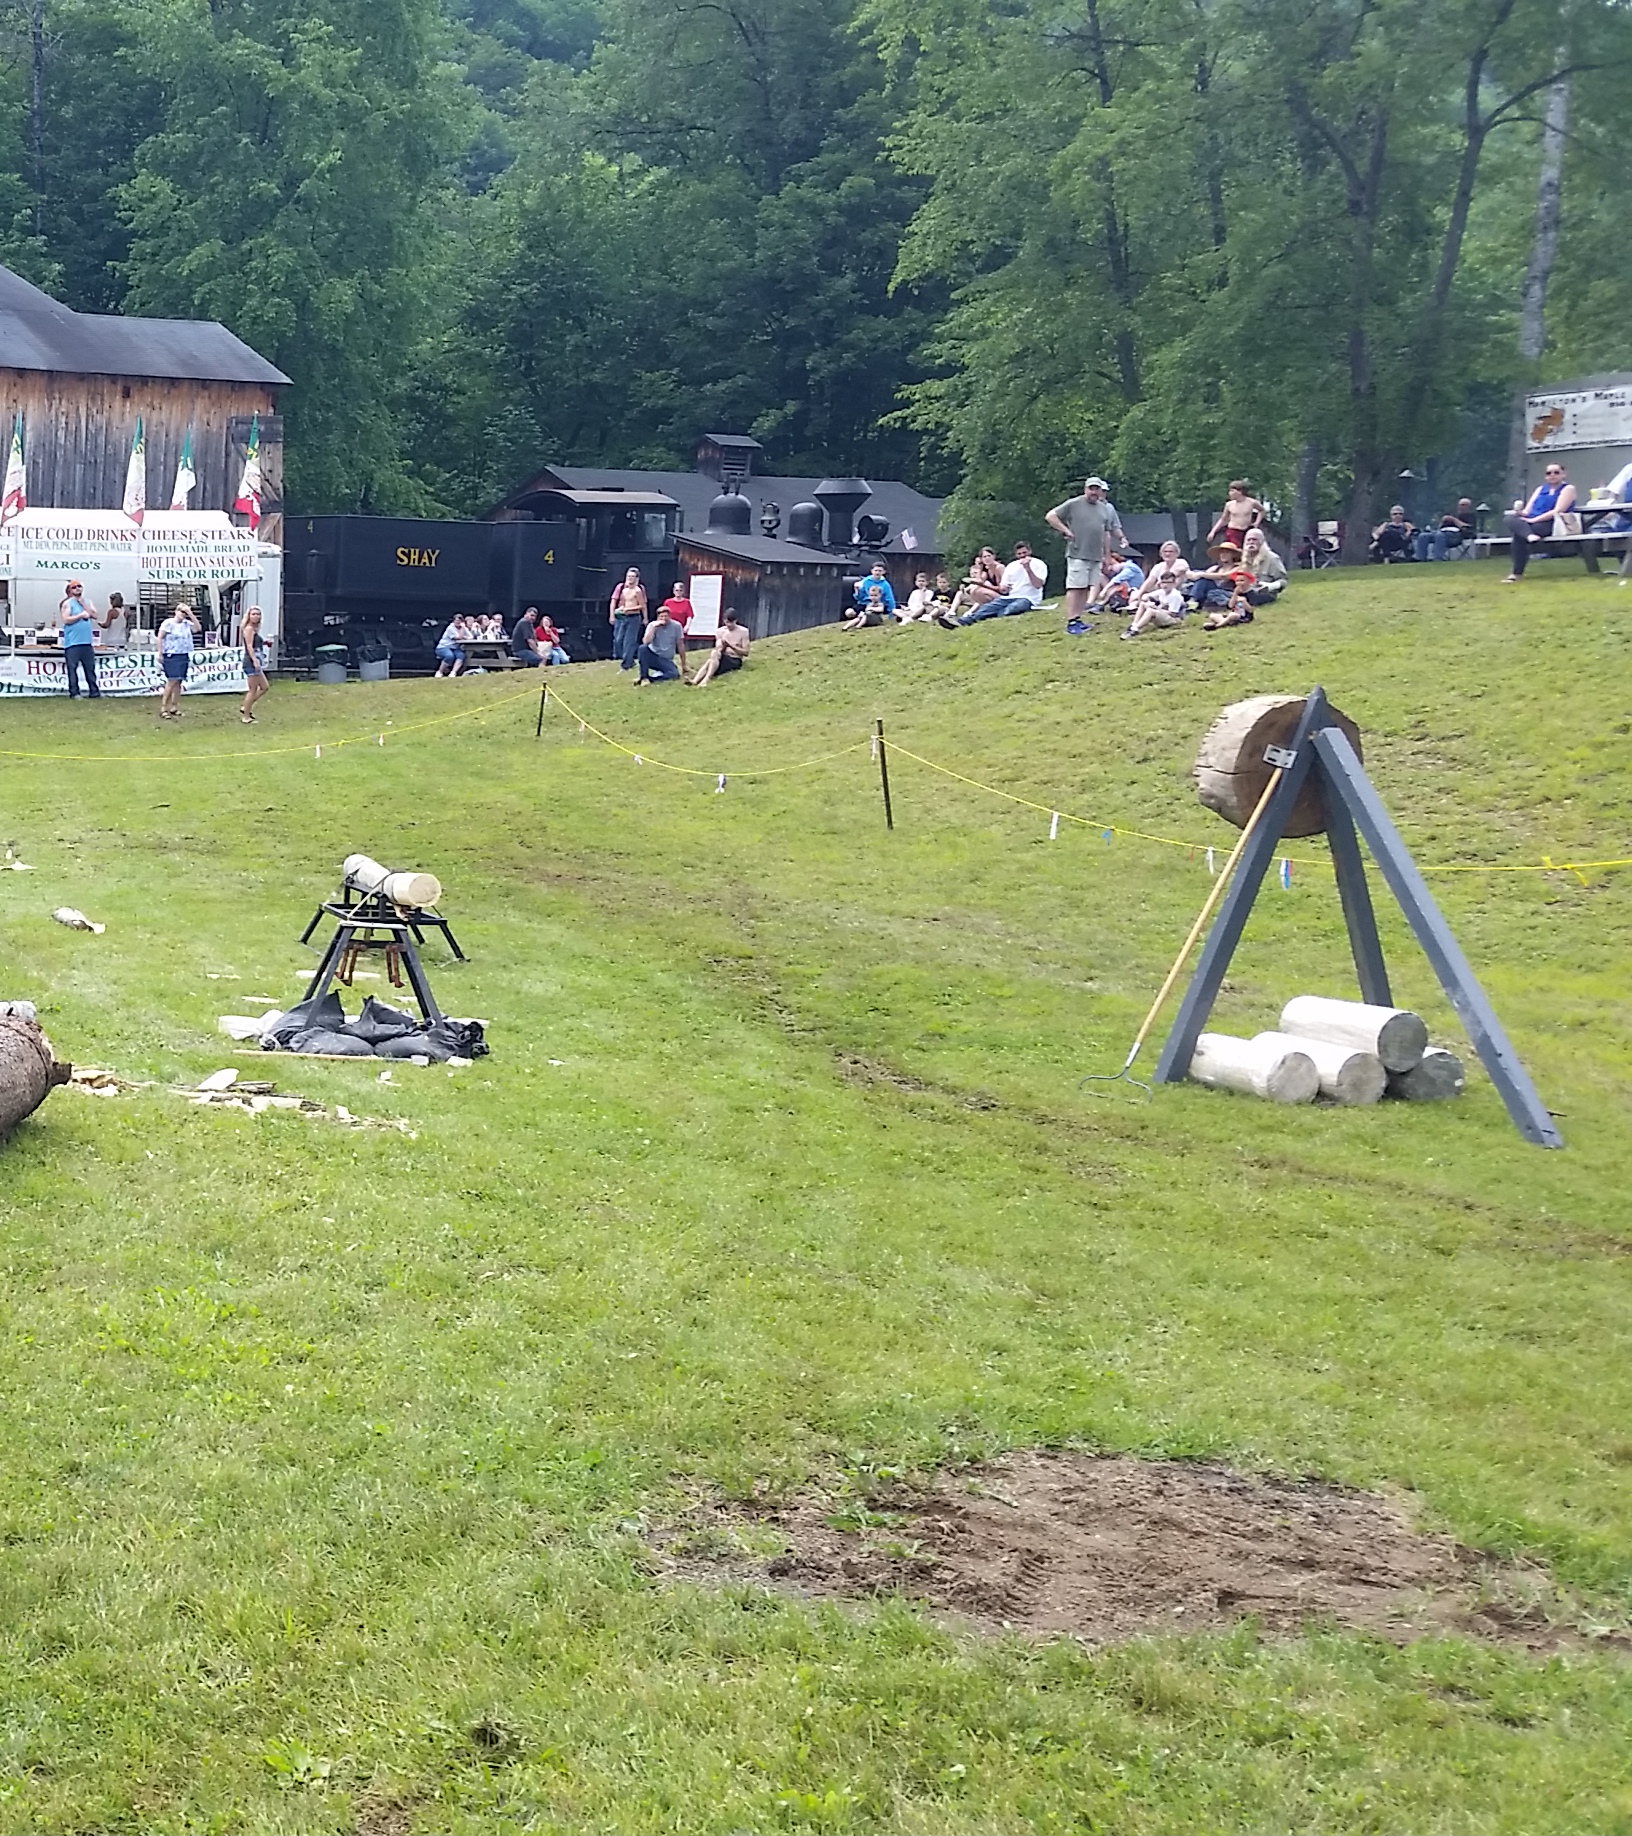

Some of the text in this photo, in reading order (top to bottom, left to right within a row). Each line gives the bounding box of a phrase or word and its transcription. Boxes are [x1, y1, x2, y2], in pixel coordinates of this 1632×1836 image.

[307, 520, 314, 533] 4
[21, 527, 137, 541] ICE COLD DRINKS
[142, 530, 255, 540] CHEESE STEAKS
[147, 545, 250, 553] HOMEMADE BREAD
[141, 555, 255, 568] HOT ITALIAN SAUSAGE
[396, 547, 441, 567] SHAY
[543, 549, 555, 564] 4
[36, 560, 101, 570] MARCO'S
[148, 569, 248, 579] SUBS OR ROLL
[99, 654, 155, 670] RESH
[100, 669, 145, 679] PIZZA
